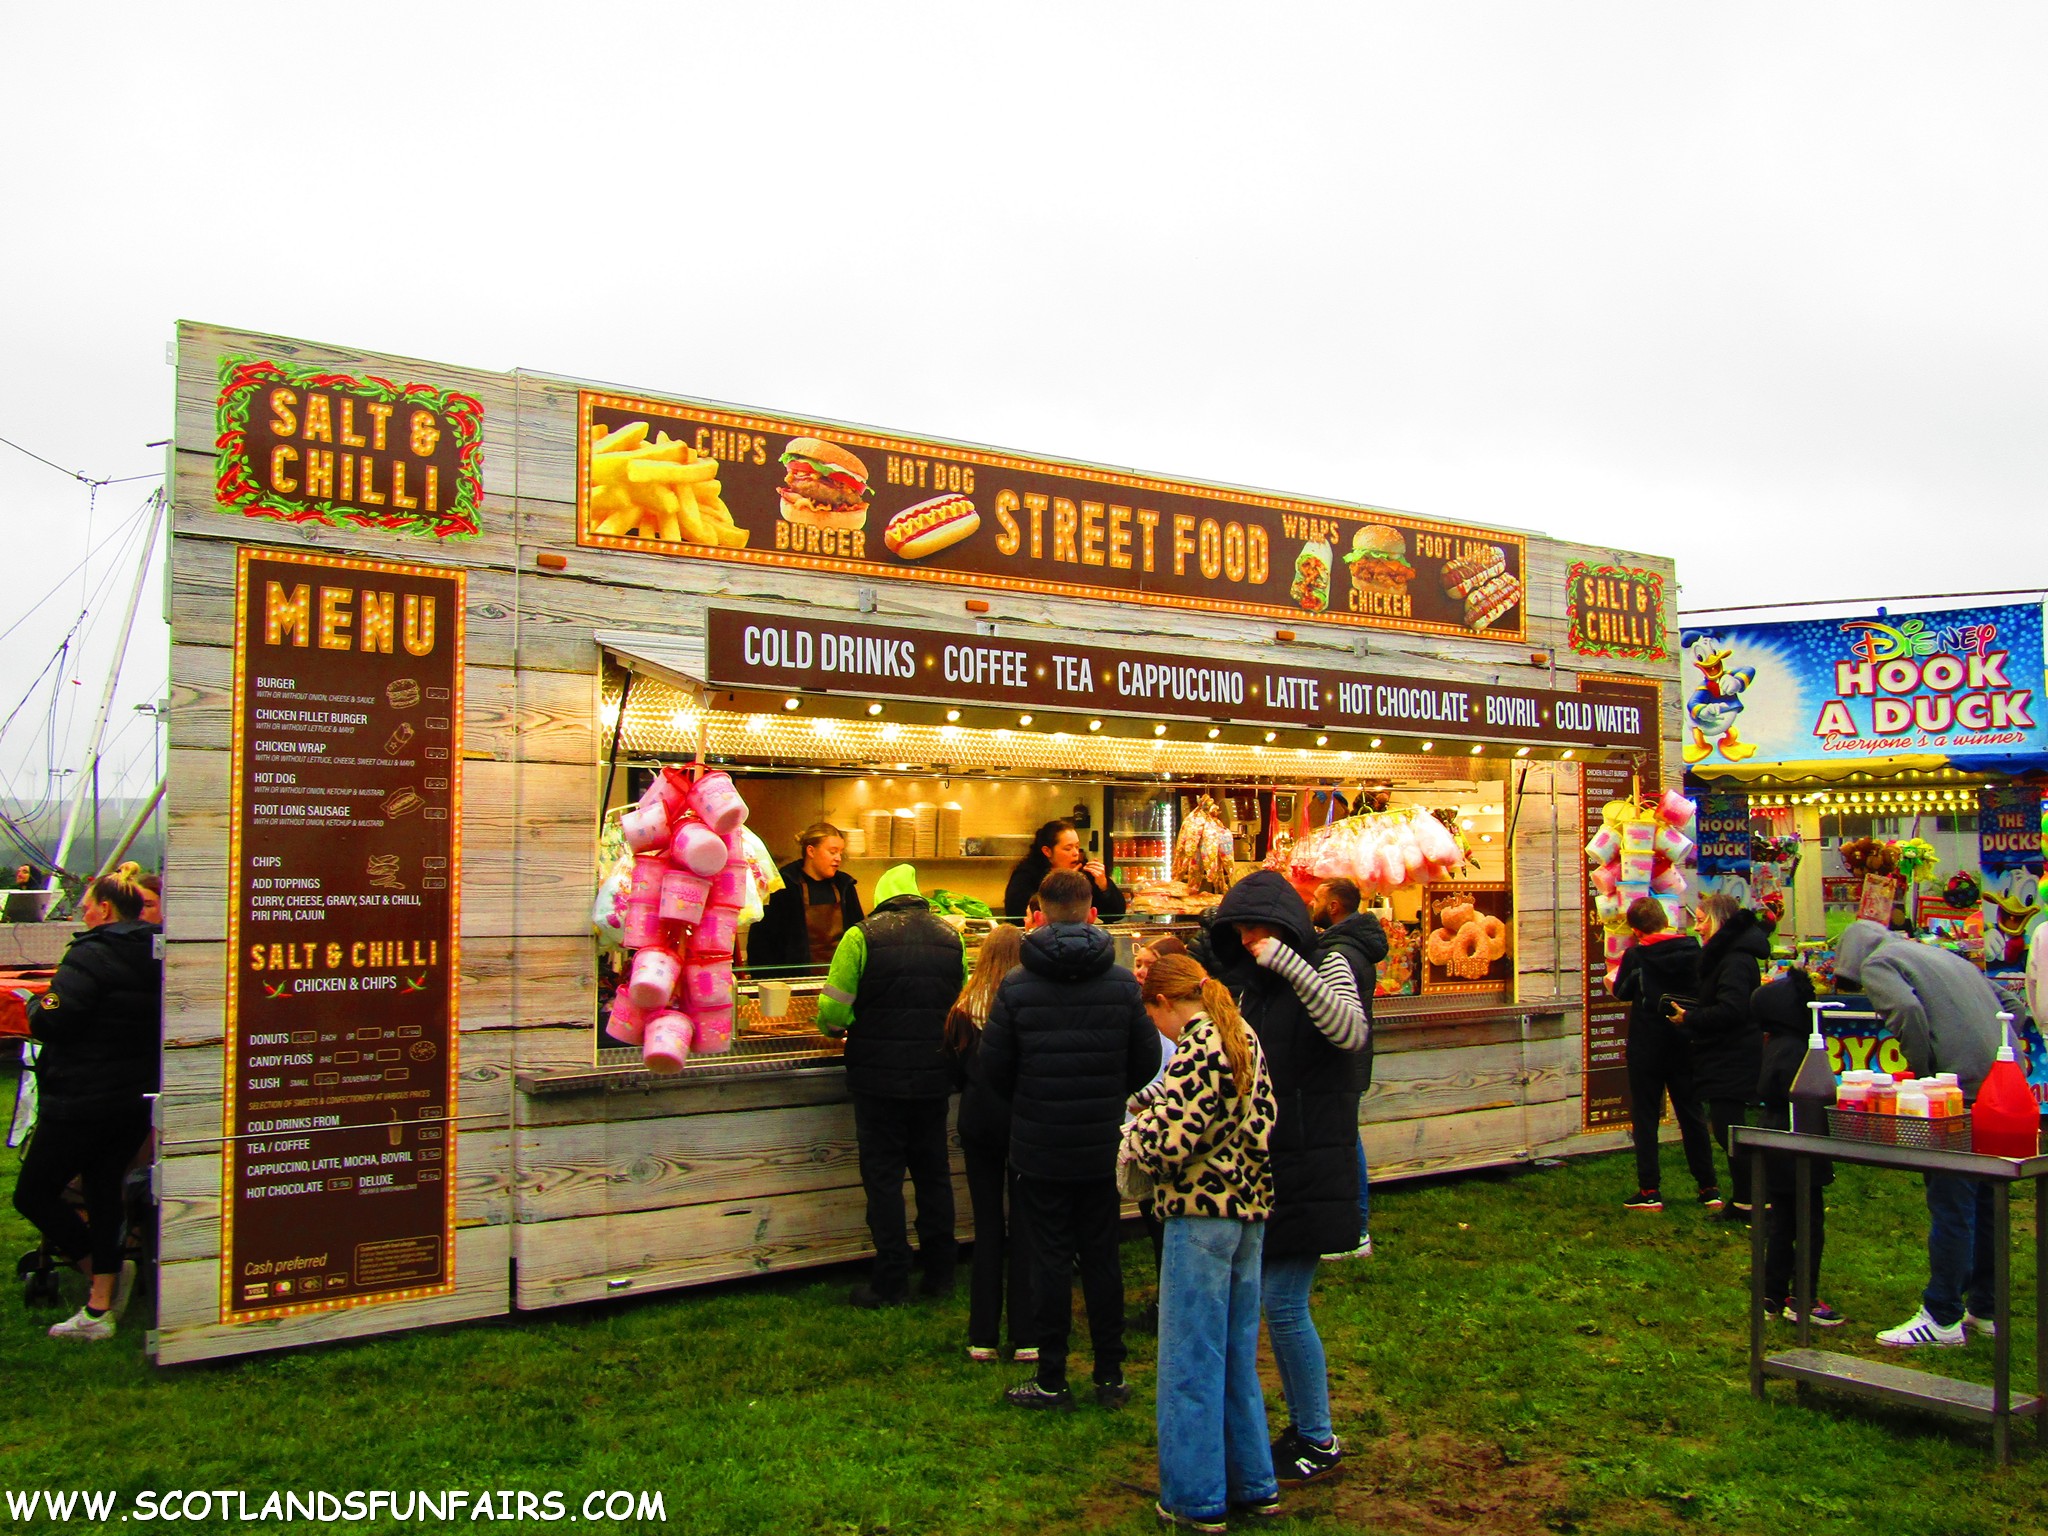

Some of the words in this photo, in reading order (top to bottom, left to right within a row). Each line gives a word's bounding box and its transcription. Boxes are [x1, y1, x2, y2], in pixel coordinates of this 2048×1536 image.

[268, 387, 393, 451] SALT
[409, 409, 440, 456] &
[696, 426, 766, 466] CHIPS
[270, 444, 439, 512] CHILLI
[886, 454, 928, 489] HOT
[934, 463, 975, 494] DOG
[995, 488, 1160, 573] STREET
[1173, 513, 1269, 585] FOOD
[1281, 513, 1340, 545] WRAPS
[775, 519, 866, 559] BURGER
[1416, 533, 1451, 560] FOOT
[1456, 539, 1490, 565] LONG
[1348, 587, 1412, 618] CHICKEN
[1584, 577, 1630, 611] SALT
[1636, 584, 1648, 613] &
[264, 580, 436, 657] MENU
[1586, 611, 1650, 646] CHILLI
[744, 625, 813, 669] COLD
[821, 632, 916, 679] DRINKS
[943, 645, 1028, 688] COFFEE
[1052, 654, 1094, 693] TEA
[1834, 650, 2012, 696] HOOK
[257, 677, 295, 689] BURGER
[1118, 661, 1244, 704] CAPPUCCINO
[271, 691, 279, 699] OR
[280, 692, 308, 700] WITHOUT
[329, 694, 350, 703] CHEESE
[356, 696, 375, 704] SAUCE
[1265, 675, 1319, 711] LATTE
[1339, 681, 1372, 715] HOT
[1376, 685, 1468, 723] CHOCOLATE
[256, 709, 297, 721] CHICKEN
[300, 710, 329, 722] FILLET
[331, 713, 368, 724] BURGER
[1485, 695, 1540, 727] BOVRIL
[1555, 700, 1592, 732] COLD
[1594, 704, 1640, 735] WATER
[1813, 700, 1857, 737] A
[1873, 690, 2035, 735] DUCK
[307, 725, 331, 733] LETTUCE
[255, 741, 296, 752] CHICKEN
[299, 743, 326, 753] WRAP
[1822, 730, 1928, 755] Everyone's
[1933, 736, 1948, 747] a
[1952, 730, 2026, 746] winner
[279, 755, 306, 763] WITHOUT
[255, 772, 273, 783] HOT
[276, 773, 296, 784] DOG
[1587, 769, 1602, 777] CHICKEN
[327, 788, 352, 796] KETCHUP
[1587, 788, 1602, 796] CHICKEN
[254, 804, 278, 815] FOOT
[281, 805, 305, 816] LONG
[307, 806, 350, 817] SAUSAGE
[1699, 819, 1748, 832] HOOK
[1998, 814, 2025, 827] THE
[1719, 832, 1727, 841] A
[1982, 832, 2041, 851] DUCKS
[1701, 843, 1746, 856] DUCK
[253, 856, 282, 867] CHIPS
[252, 878, 272, 889] ADD
[274, 878, 320, 889] TOPPINGS
[252, 896, 284, 907] CURRY,
[287, 896, 324, 907] CHEESE,
[327, 895, 358, 906] GRAVY,
[359, 895, 380, 905] SALT
[382, 896, 390, 905] &
[391, 895, 421, 906] CHILLI,
[252, 910, 270, 921] PIRI
[273, 910, 293, 922] PIRI,
[295, 910, 325, 920] CAJUN
[251, 942, 318, 971] SALT
[326, 942, 344, 968] &
[352, 939, 437, 968] CHILLI
[294, 978, 346, 992] CHICKEN
[350, 978, 359, 990] &
[362, 976, 397, 990] CHIPS
[250, 1033, 289, 1045] DONUTS
[321, 1034, 337, 1042] EACH
[346, 1033, 354, 1041] OR
[249, 1055, 282, 1068] CANDY
[284, 1054, 313, 1066] FLOSS
[249, 1078, 280, 1089] SLUSH
[290, 1079, 309, 1087] SMALL
[342, 1074, 370, 1084] SOUVENIR
[248, 1101, 284, 1111] SELECTION
[285, 1100, 293, 1108] OF
[293, 1098, 319, 1108] SWEETS
[326, 1093, 375, 1105] CONFECTIONERY
[375, 1092, 383, 1100] AT
[384, 1091, 407, 1100] VARIOUS
[409, 1090, 431, 1098] PRICES
[248, 1121, 273, 1133] COLD
[276, 1118, 311, 1130] DRINKS
[314, 1115, 340, 1128] FROM
[247, 1142, 265, 1154] TEA
[268, 1142, 273, 1152] /
[275, 1138, 310, 1151] COFFEE
[247, 1160, 310, 1177] CAPPUCCINO,
[312, 1158, 342, 1171] LATTE,
[344, 1155, 379, 1167] MOCHA,
[381, 1151, 413, 1164] BOVRIL
[247, 1187, 266, 1199] HOT
[268, 1181, 323, 1197] CHOCOLATE
[359, 1174, 394, 1188] DELUXE
[245, 1261, 273, 1276] Cash
[275, 1253, 328, 1275] preferred
[248, 1287, 265, 1295] VISA
